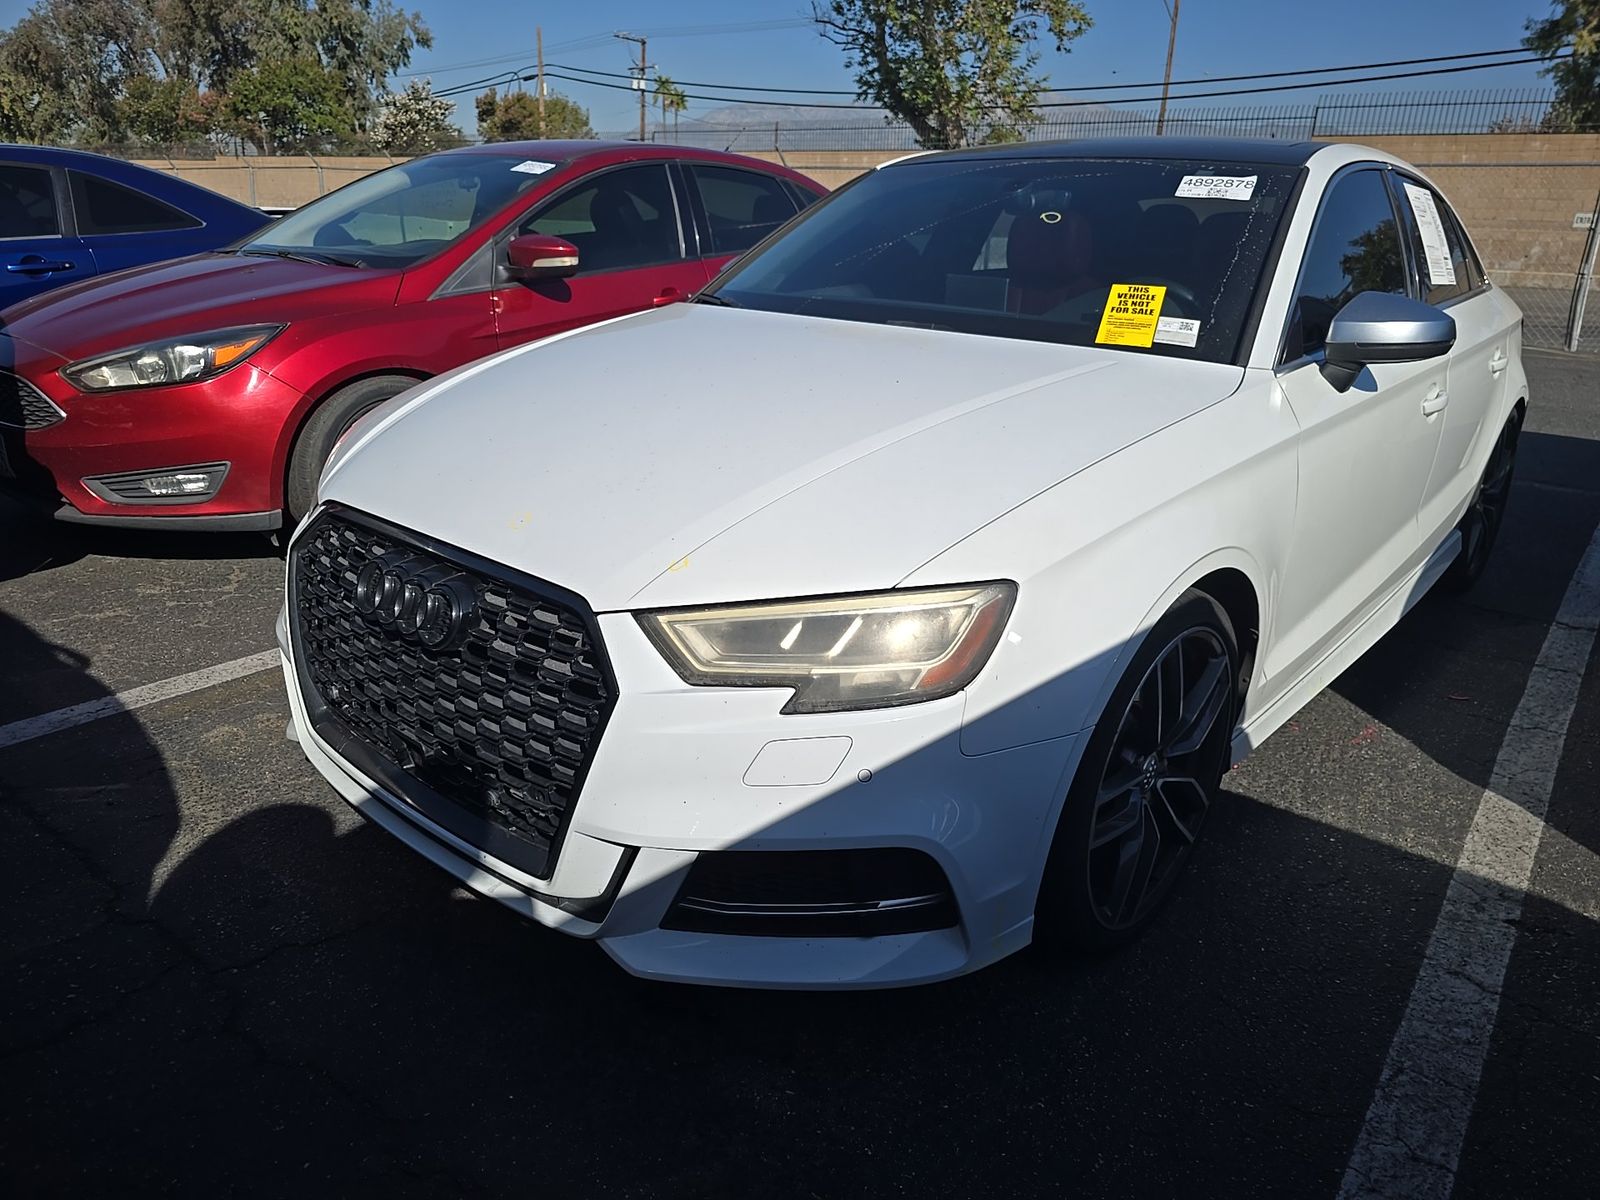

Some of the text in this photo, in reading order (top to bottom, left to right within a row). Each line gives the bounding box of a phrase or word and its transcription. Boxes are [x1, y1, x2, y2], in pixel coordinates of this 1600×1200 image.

[1183, 178, 1255, 189] 4892878
[1117, 293, 1156, 301] VEHICLE
[1131, 308, 1155, 316] SALE
